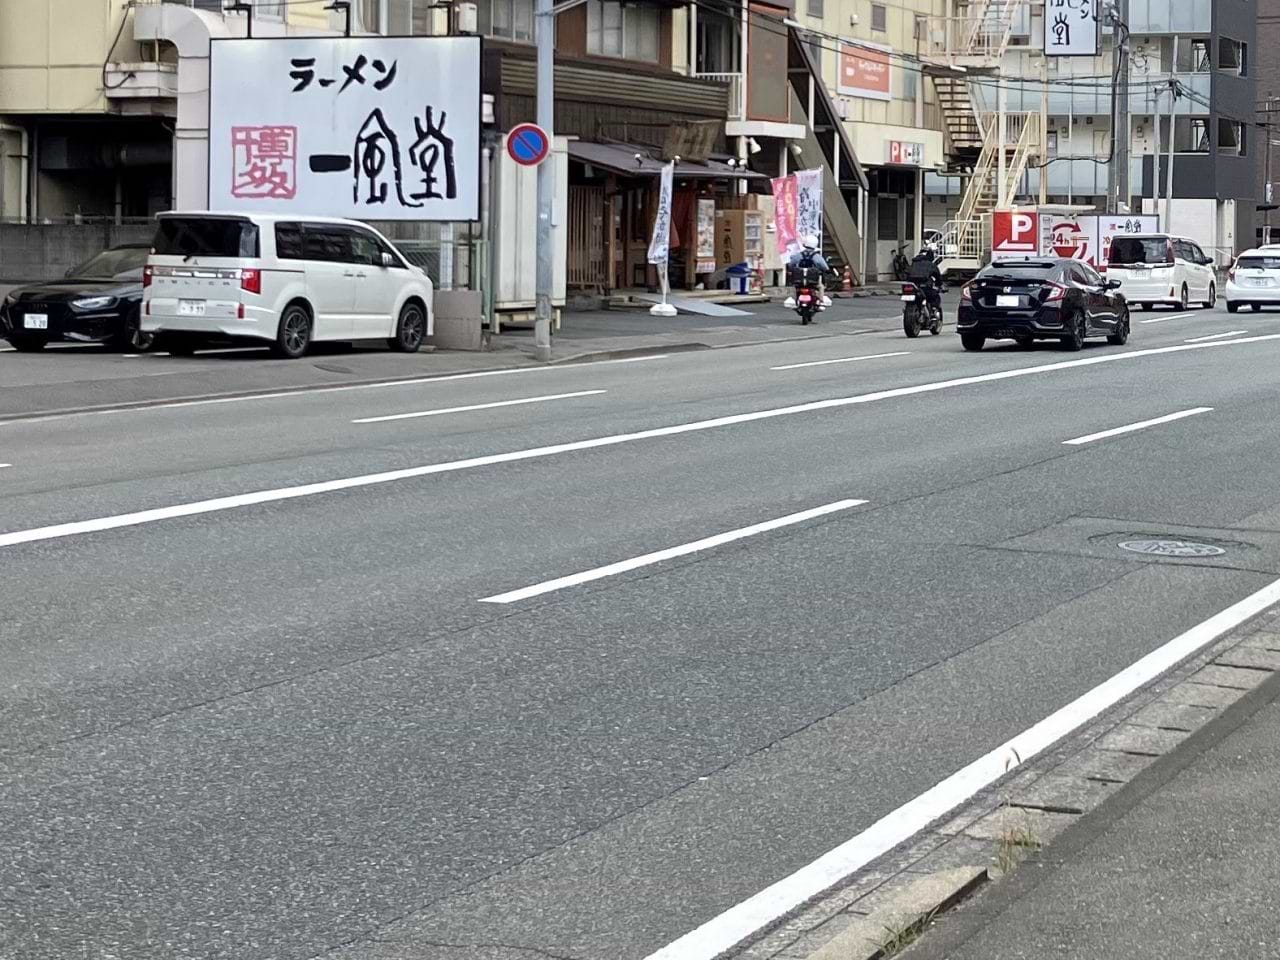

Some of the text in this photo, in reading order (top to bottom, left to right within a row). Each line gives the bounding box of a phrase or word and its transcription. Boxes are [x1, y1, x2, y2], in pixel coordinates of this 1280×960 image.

[289, 54, 398, 94] ラーメン
[309, 105, 457, 208] 一風堂
[1011, 214, 1032, 240] P
